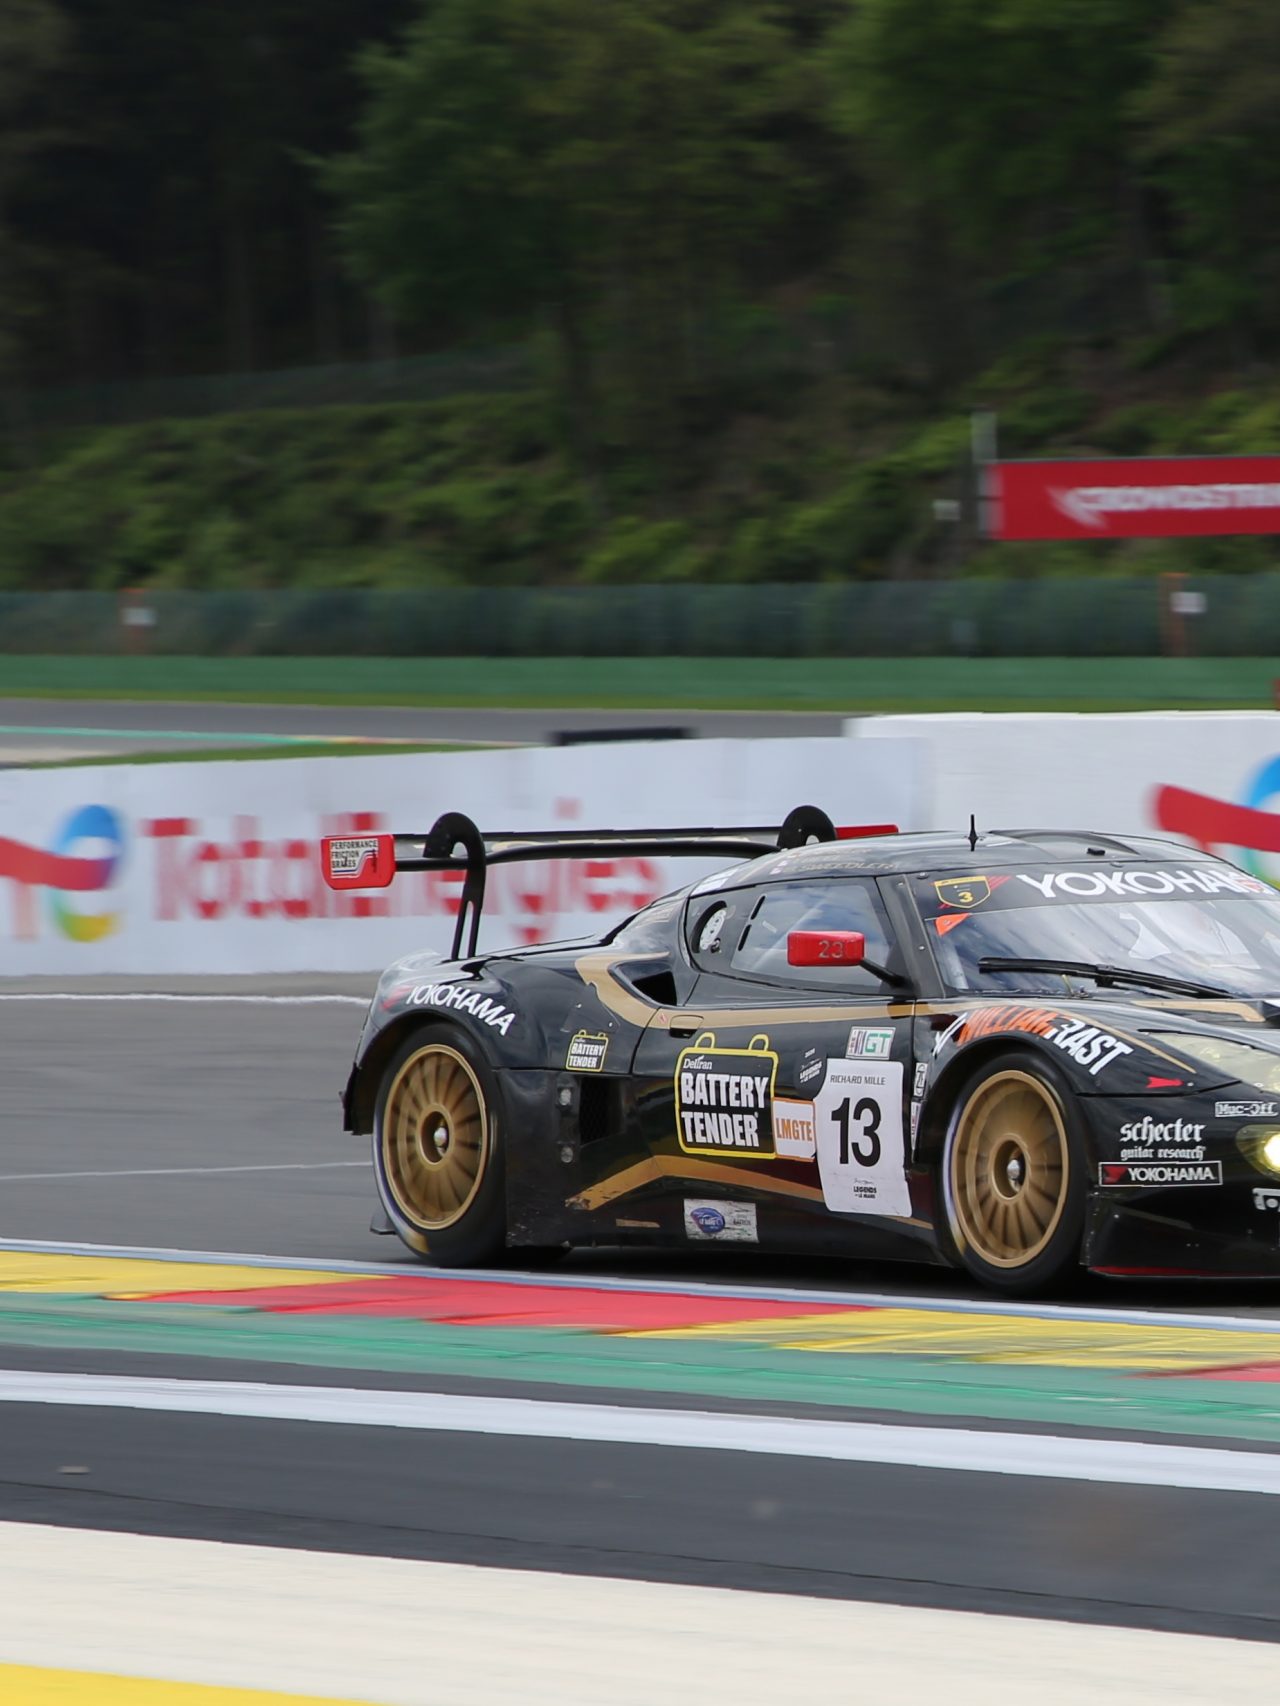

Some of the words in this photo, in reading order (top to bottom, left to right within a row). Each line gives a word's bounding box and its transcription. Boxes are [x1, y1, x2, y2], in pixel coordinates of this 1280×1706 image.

[330, 840, 377, 849] PERFORMANCE
[331, 851, 359, 859] FRICTION
[958, 891, 974, 903] 3
[818, 940, 844, 959] 23
[406, 984, 517, 1036] YOKOHAMA
[571, 1042, 606, 1056] BATTERY
[569, 1055, 598, 1068] TENDER
[830, 1074, 862, 1085] RICHARD
[864, 1076, 886, 1086] MILLE
[680, 1072, 769, 1109] BATTERY
[681, 1111, 759, 1147] TENDER
[775, 1118, 813, 1142] LMGTE
[831, 1097, 881, 1168] 13
[1119, 1115, 1207, 1146] schecter
[1120, 1146, 1154, 1161] guitar
[1157, 1145, 1206, 1161] research
[1128, 1166, 1215, 1181] YOKOHAMA
